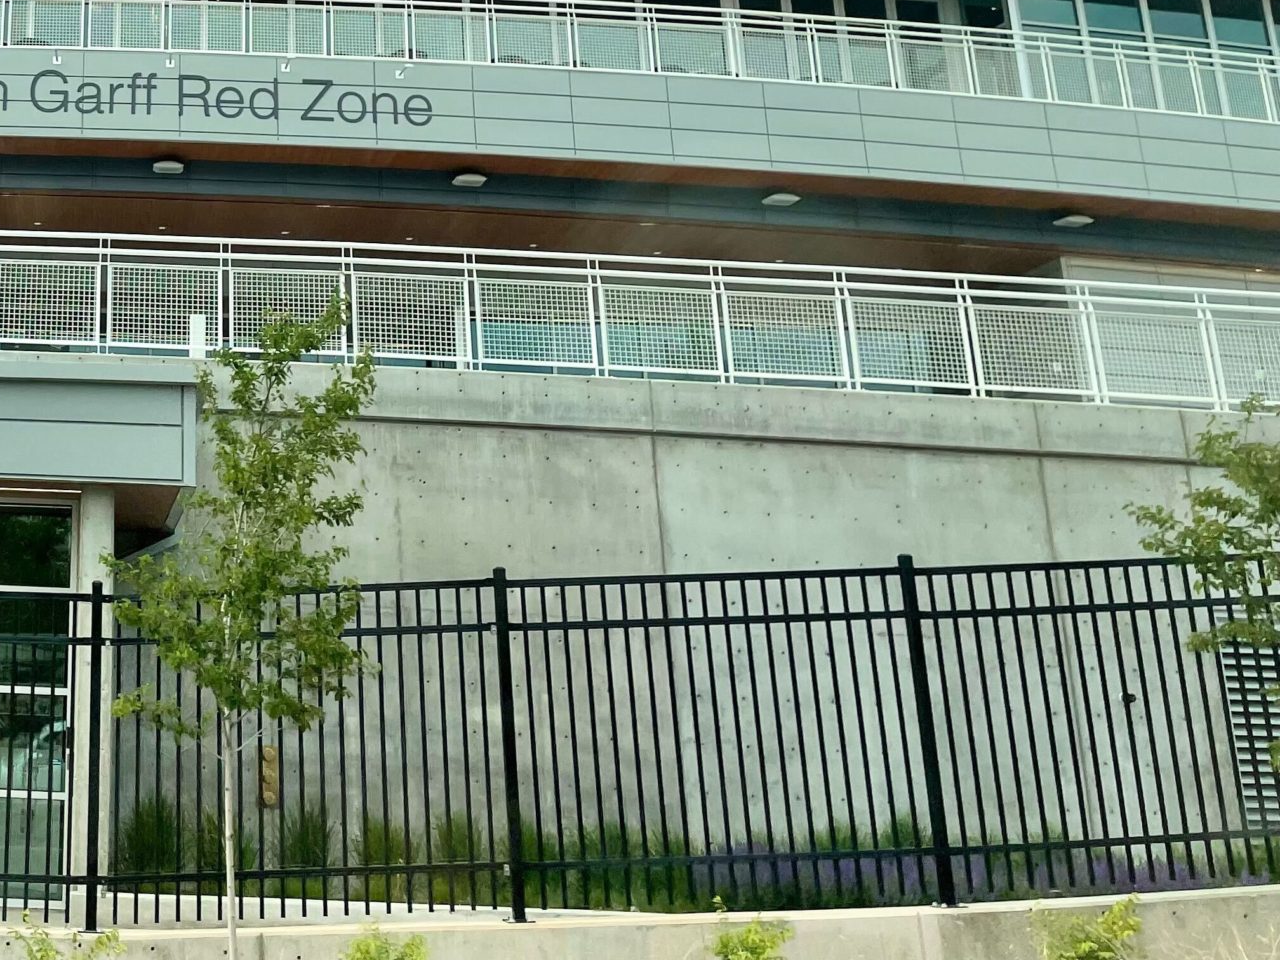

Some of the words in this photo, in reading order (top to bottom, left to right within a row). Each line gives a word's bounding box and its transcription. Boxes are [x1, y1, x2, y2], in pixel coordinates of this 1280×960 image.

[28, 68, 158, 115] Garff
[177, 73, 280, 120] Red
[299, 78, 434, 127] Zone
